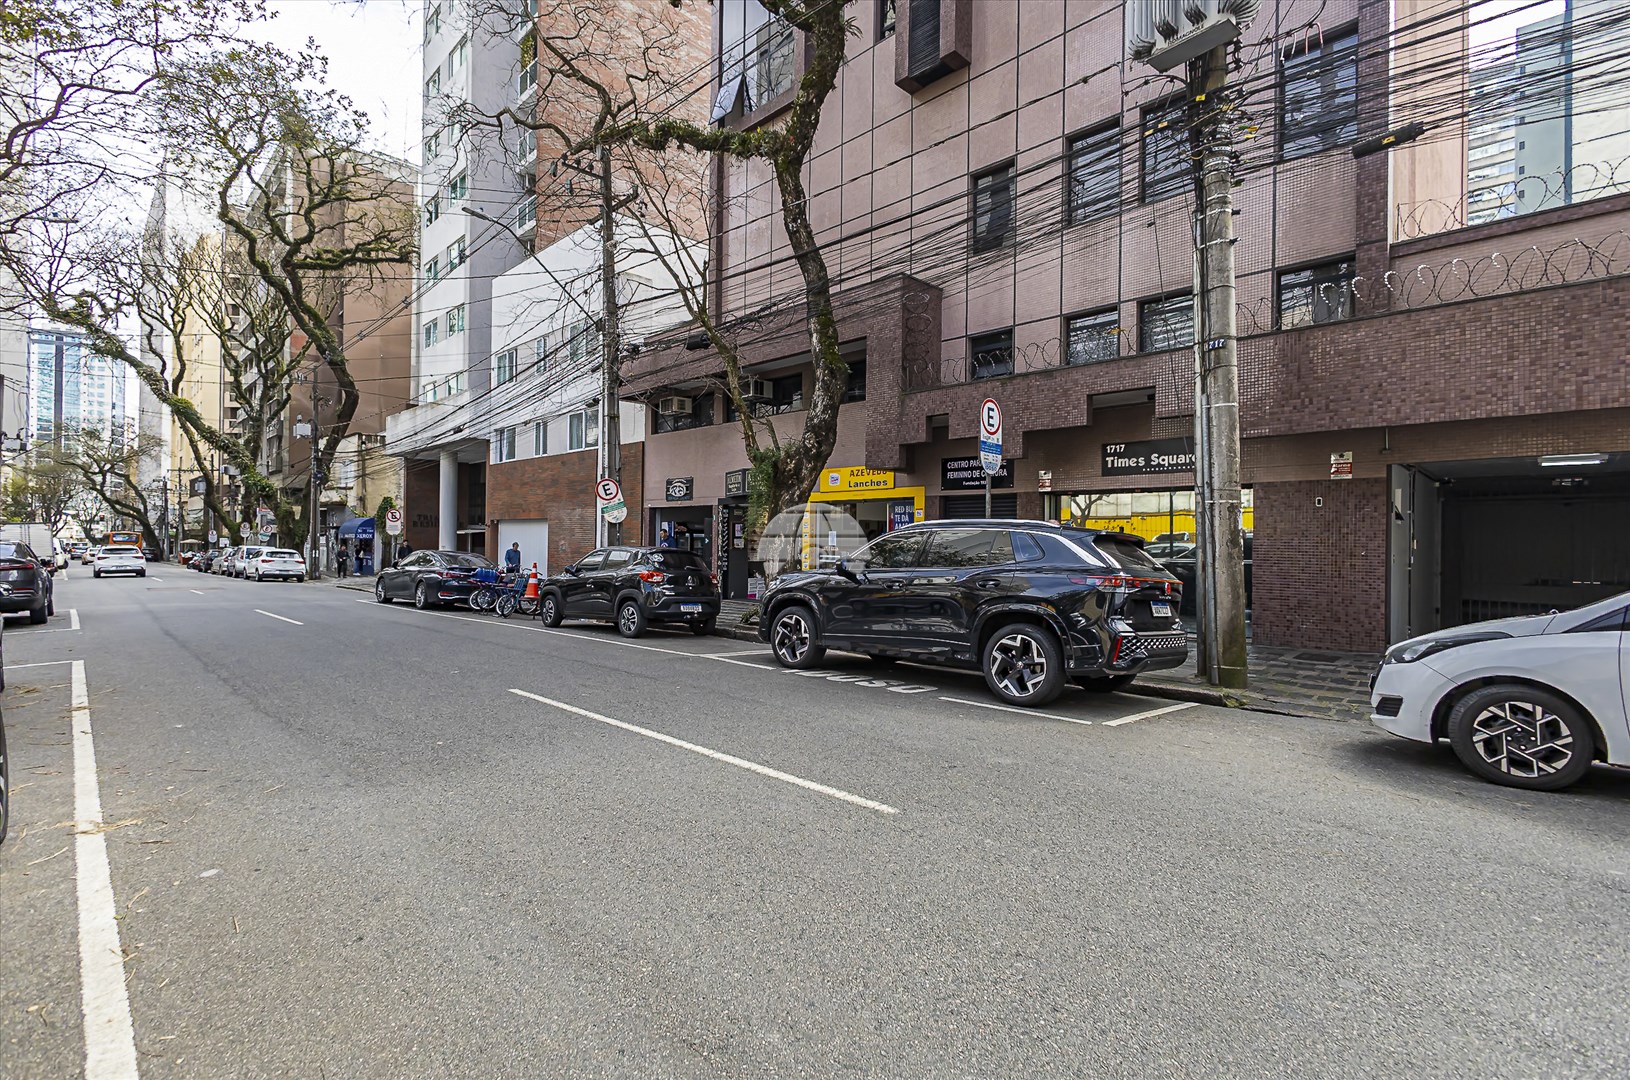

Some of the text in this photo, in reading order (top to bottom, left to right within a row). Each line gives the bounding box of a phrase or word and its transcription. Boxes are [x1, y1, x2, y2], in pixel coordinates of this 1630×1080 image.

[987, 406, 995, 428] E
[1105, 444, 1125, 453] 1717
[947, 460, 969, 469] CENTRO
[1105, 456, 1145, 468] Times
[947, 470, 972, 479] FEMININO
[972, 470, 980, 478] DE
[848, 479, 888, 488] Lanches
[602, 482, 613, 497] E
[895, 505, 905, 513] RED
[895, 514, 901, 522] TE
